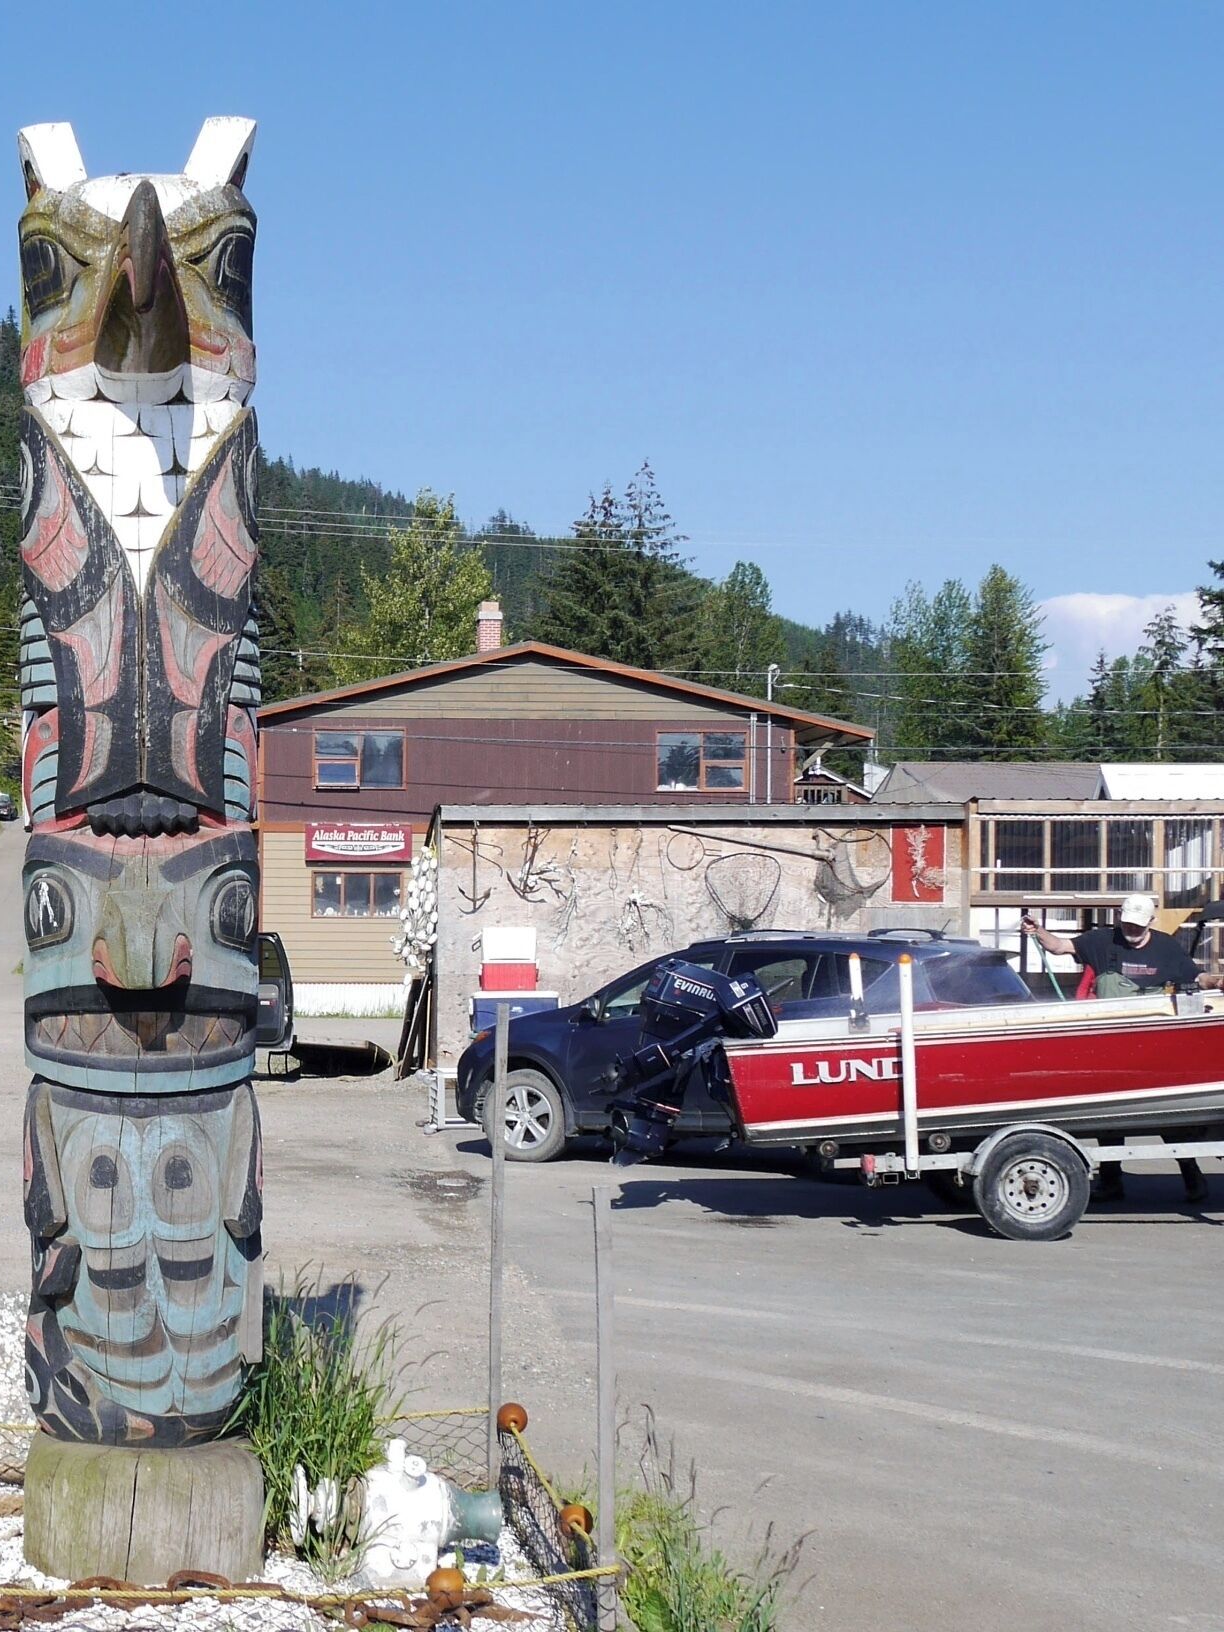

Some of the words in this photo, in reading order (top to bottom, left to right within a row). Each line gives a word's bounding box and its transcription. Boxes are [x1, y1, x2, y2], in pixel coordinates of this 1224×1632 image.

[313, 830, 345, 841] Alaska
[347, 830, 379, 841] Pacific
[380, 830, 405, 841] Bank
[674, 979, 717, 1001] EVINRU
